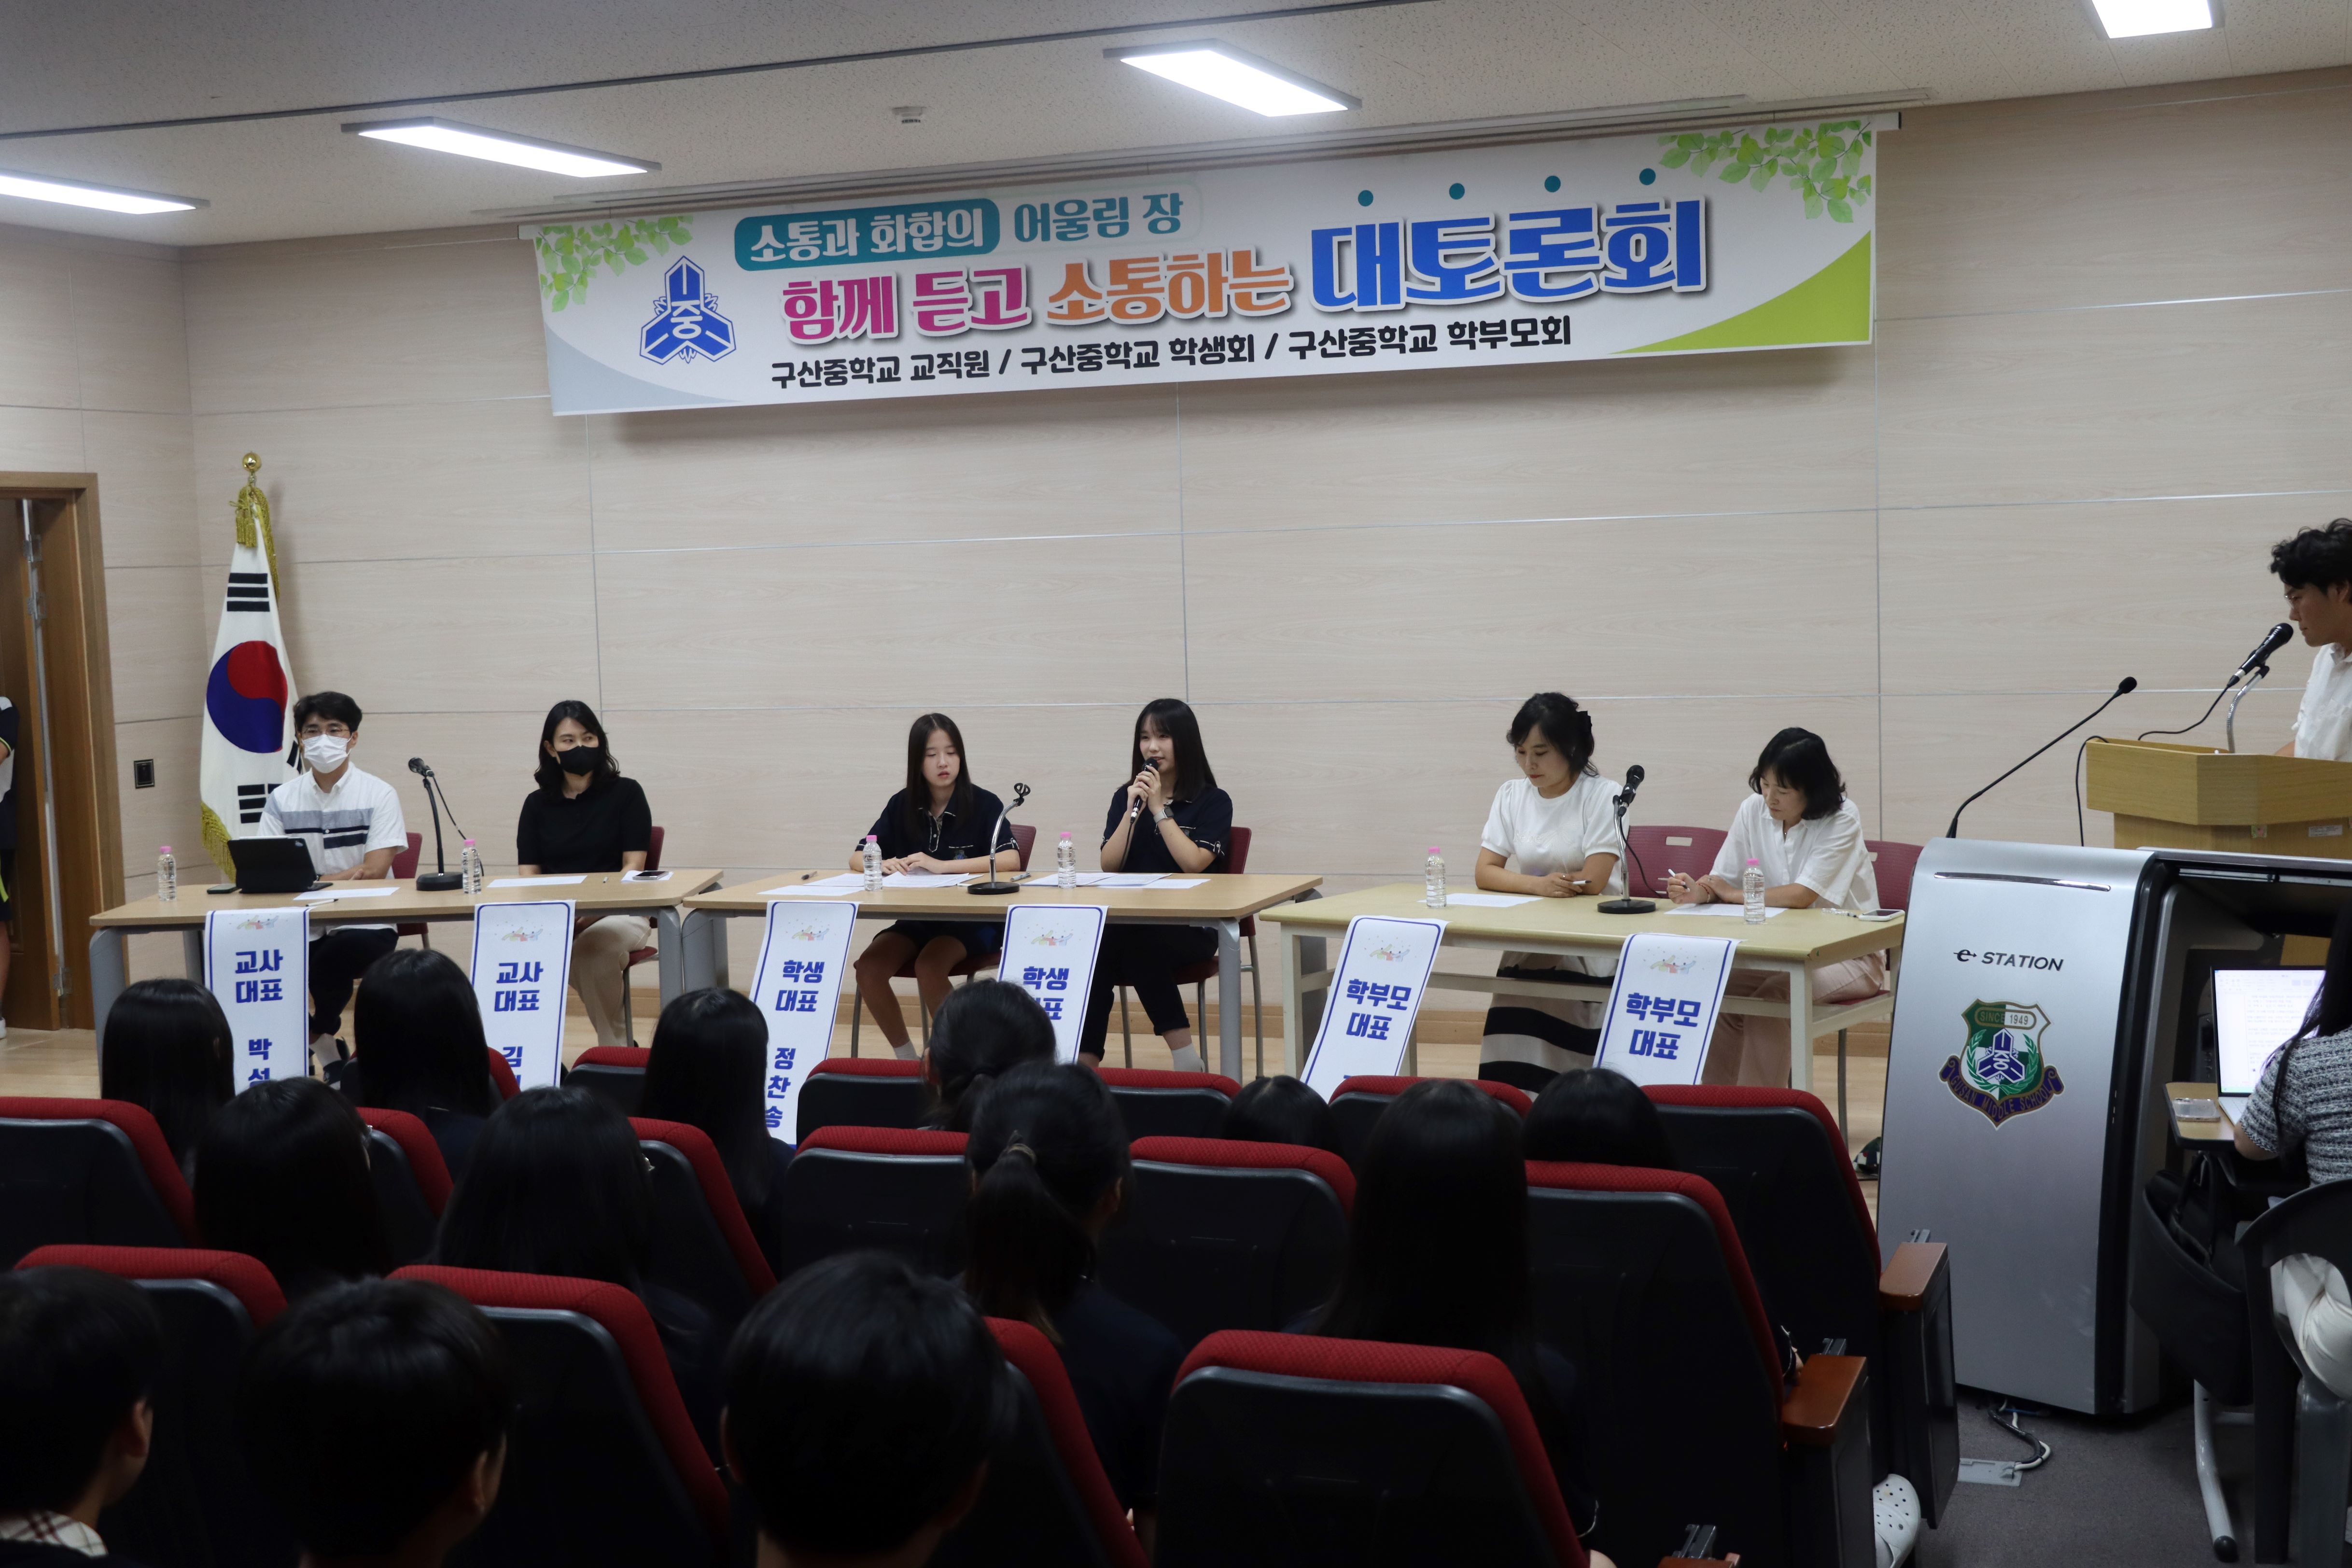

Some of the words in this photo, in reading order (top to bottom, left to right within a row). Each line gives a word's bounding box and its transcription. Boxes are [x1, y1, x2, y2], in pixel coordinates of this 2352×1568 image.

[750, 217, 860, 263] 소통과
[870, 207, 984, 254] 화합의
[1014, 197, 1130, 243] 어울림
[1142, 192, 1184, 235] 장
[782, 276, 895, 341] 함께
[913, 267, 1028, 333] 듣고
[1047, 249, 1290, 321] 소통하는
[1311, 199, 1706, 308] 대토론회
[771, 355, 901, 389] 구산중학교
[910, 349, 990, 381] 교직원
[1021, 340, 1161, 376] 구산중학교
[1168, 333, 1255, 367] 학생회
[1288, 324, 1439, 361] 구산중학교
[1447, 316, 1572, 350] 학부모회
[235, 949, 283, 974] 교사
[496, 962, 544, 983] 교사
[783, 960, 825, 983] 학생
[1981, 952, 2064, 972] STATION
[236, 979, 283, 1003] 대표
[1023, 966, 1069, 990] 학생
[494, 990, 540, 1012] 대표
[775, 990, 819, 1012] 대표
[1346, 979, 1412, 1010] 학부모
[1032, 997, 1064, 1020] 표
[1626, 993, 1701, 1027] 학부모
[1980, 1011, 2005, 1023] SINCE
[2009, 1015, 2029, 1025] 1949
[1346, 1012, 1392, 1040] 대표
[1629, 1029, 1681, 1060] 대표
[503, 1046, 523, 1087] 김
[765, 1048, 796, 1128] 정찬송
[1950, 1076, 1978, 1103] GUSAN
[1981, 1096, 2015, 1119] MIDDLE
[2020, 1079, 2053, 1110] SCHOOL
